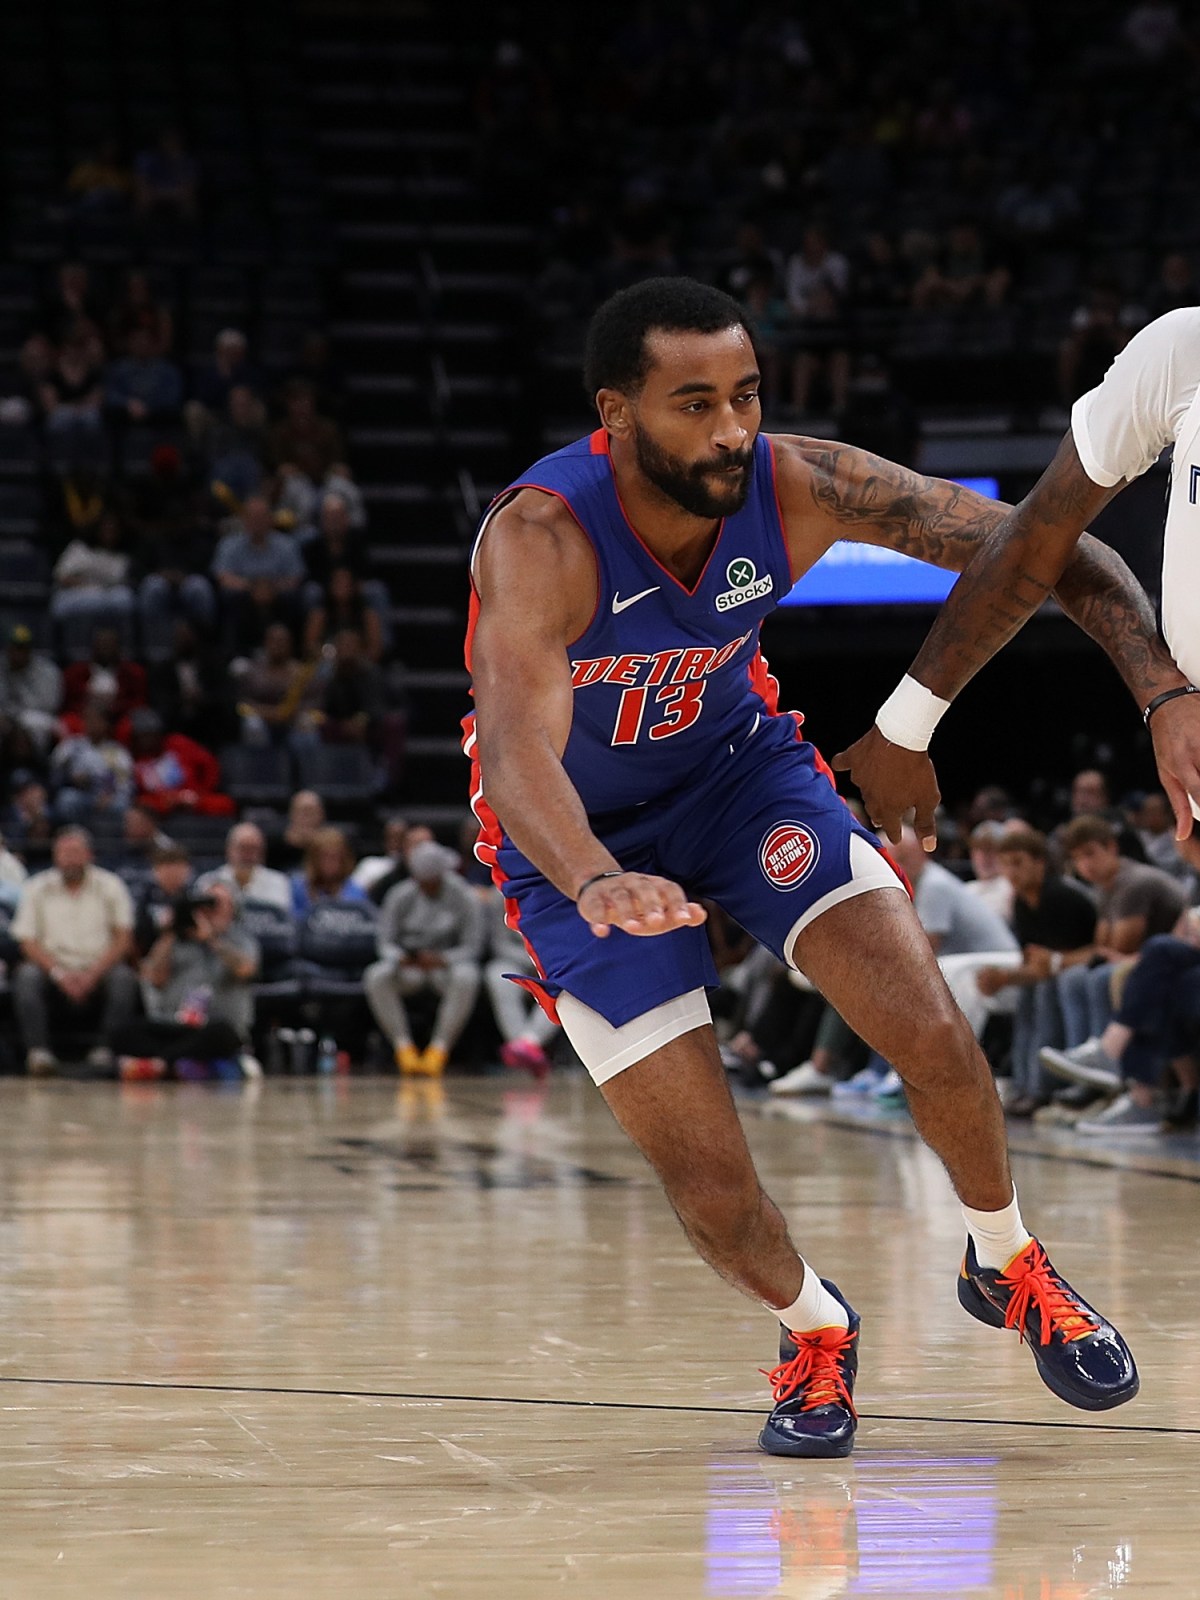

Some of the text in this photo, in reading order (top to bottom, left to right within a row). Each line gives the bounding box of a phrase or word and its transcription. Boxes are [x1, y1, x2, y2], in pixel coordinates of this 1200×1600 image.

[610, 679, 708, 747] 13
[767, 834, 802, 866] DETROIT
[771, 843, 808, 876] PISTONS
